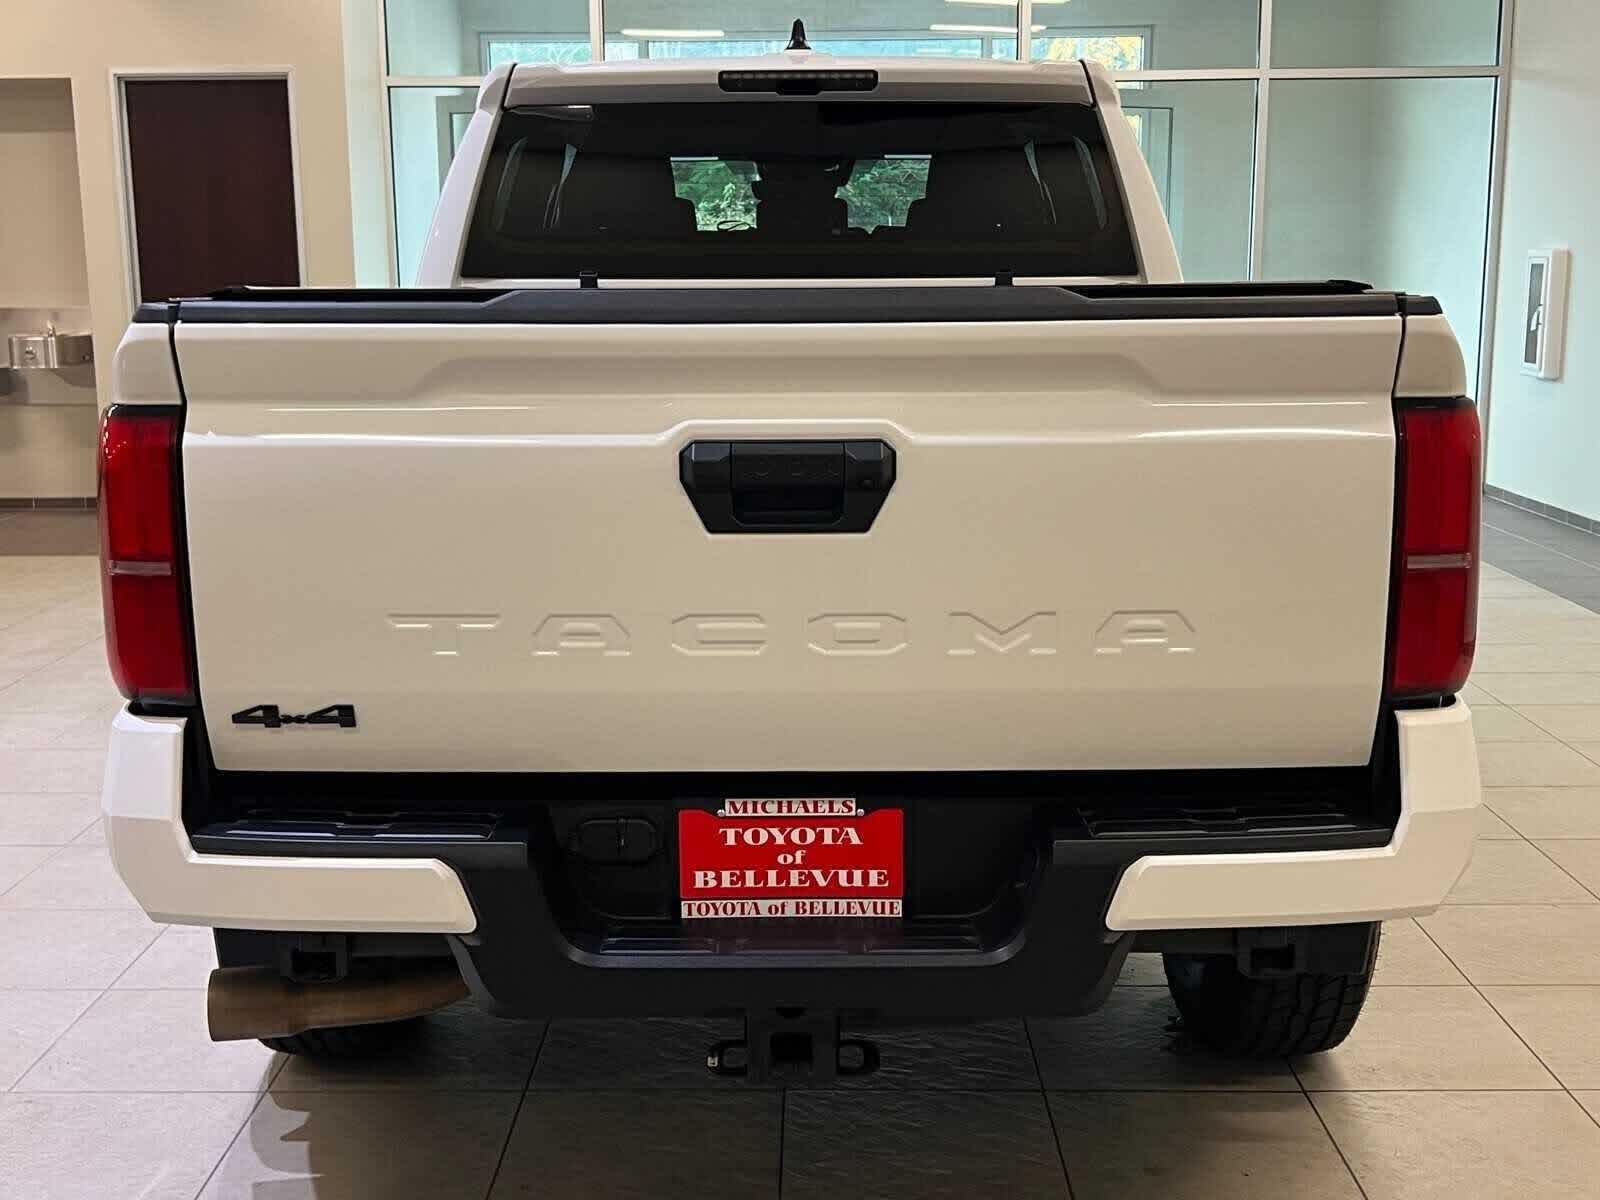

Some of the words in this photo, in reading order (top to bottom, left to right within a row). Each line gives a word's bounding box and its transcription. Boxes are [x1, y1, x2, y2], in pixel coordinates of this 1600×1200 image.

[386, 611, 1196, 656] TACOMA
[728, 800, 855, 815] MICHAELS
[719, 827, 864, 846] TOYOTA
[776, 849, 807, 865] of
[693, 869, 890, 889] BELLEVUE
[683, 902, 761, 917] TOYOTA
[768, 901, 788, 916] of
[794, 901, 901, 916] BELLEVUE
